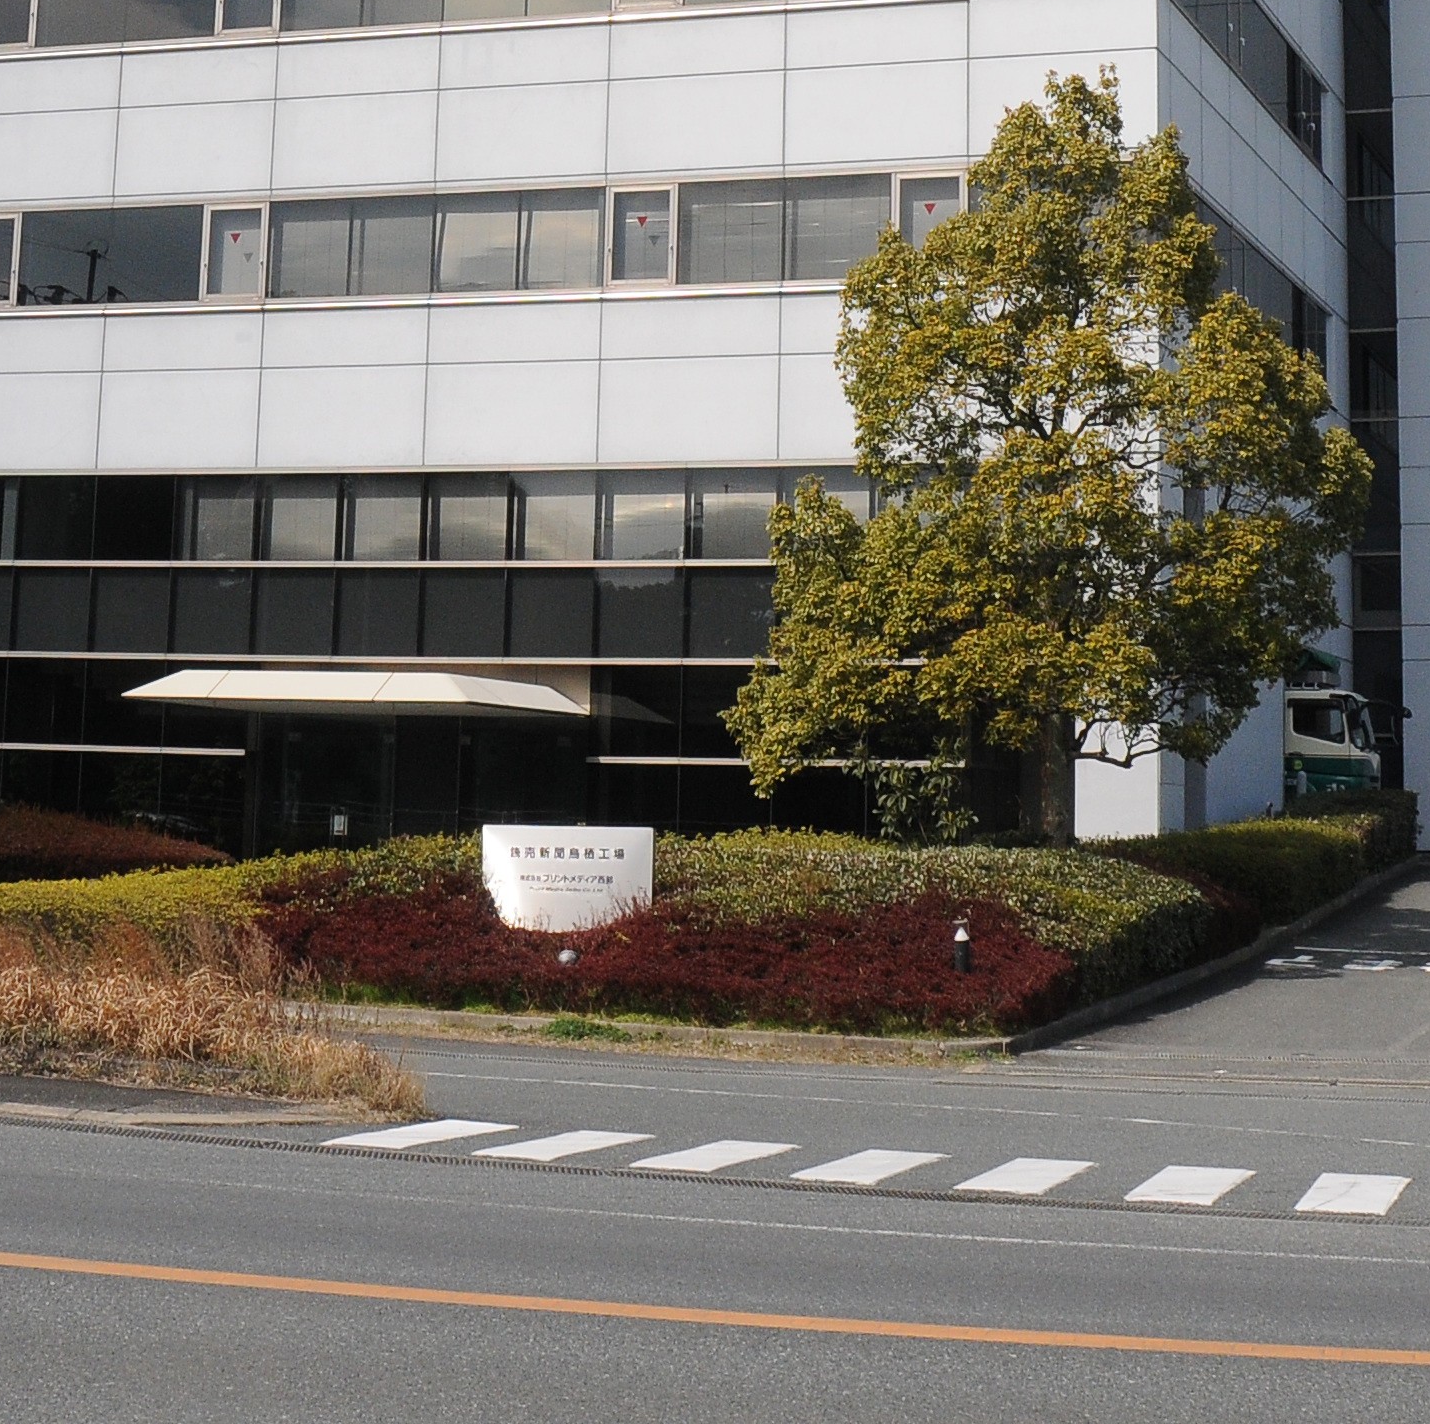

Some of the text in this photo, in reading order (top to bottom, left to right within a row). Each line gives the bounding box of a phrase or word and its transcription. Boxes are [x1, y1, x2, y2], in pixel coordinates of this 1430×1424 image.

[510, 847, 625, 860] 読売新聞鳥栖工場
